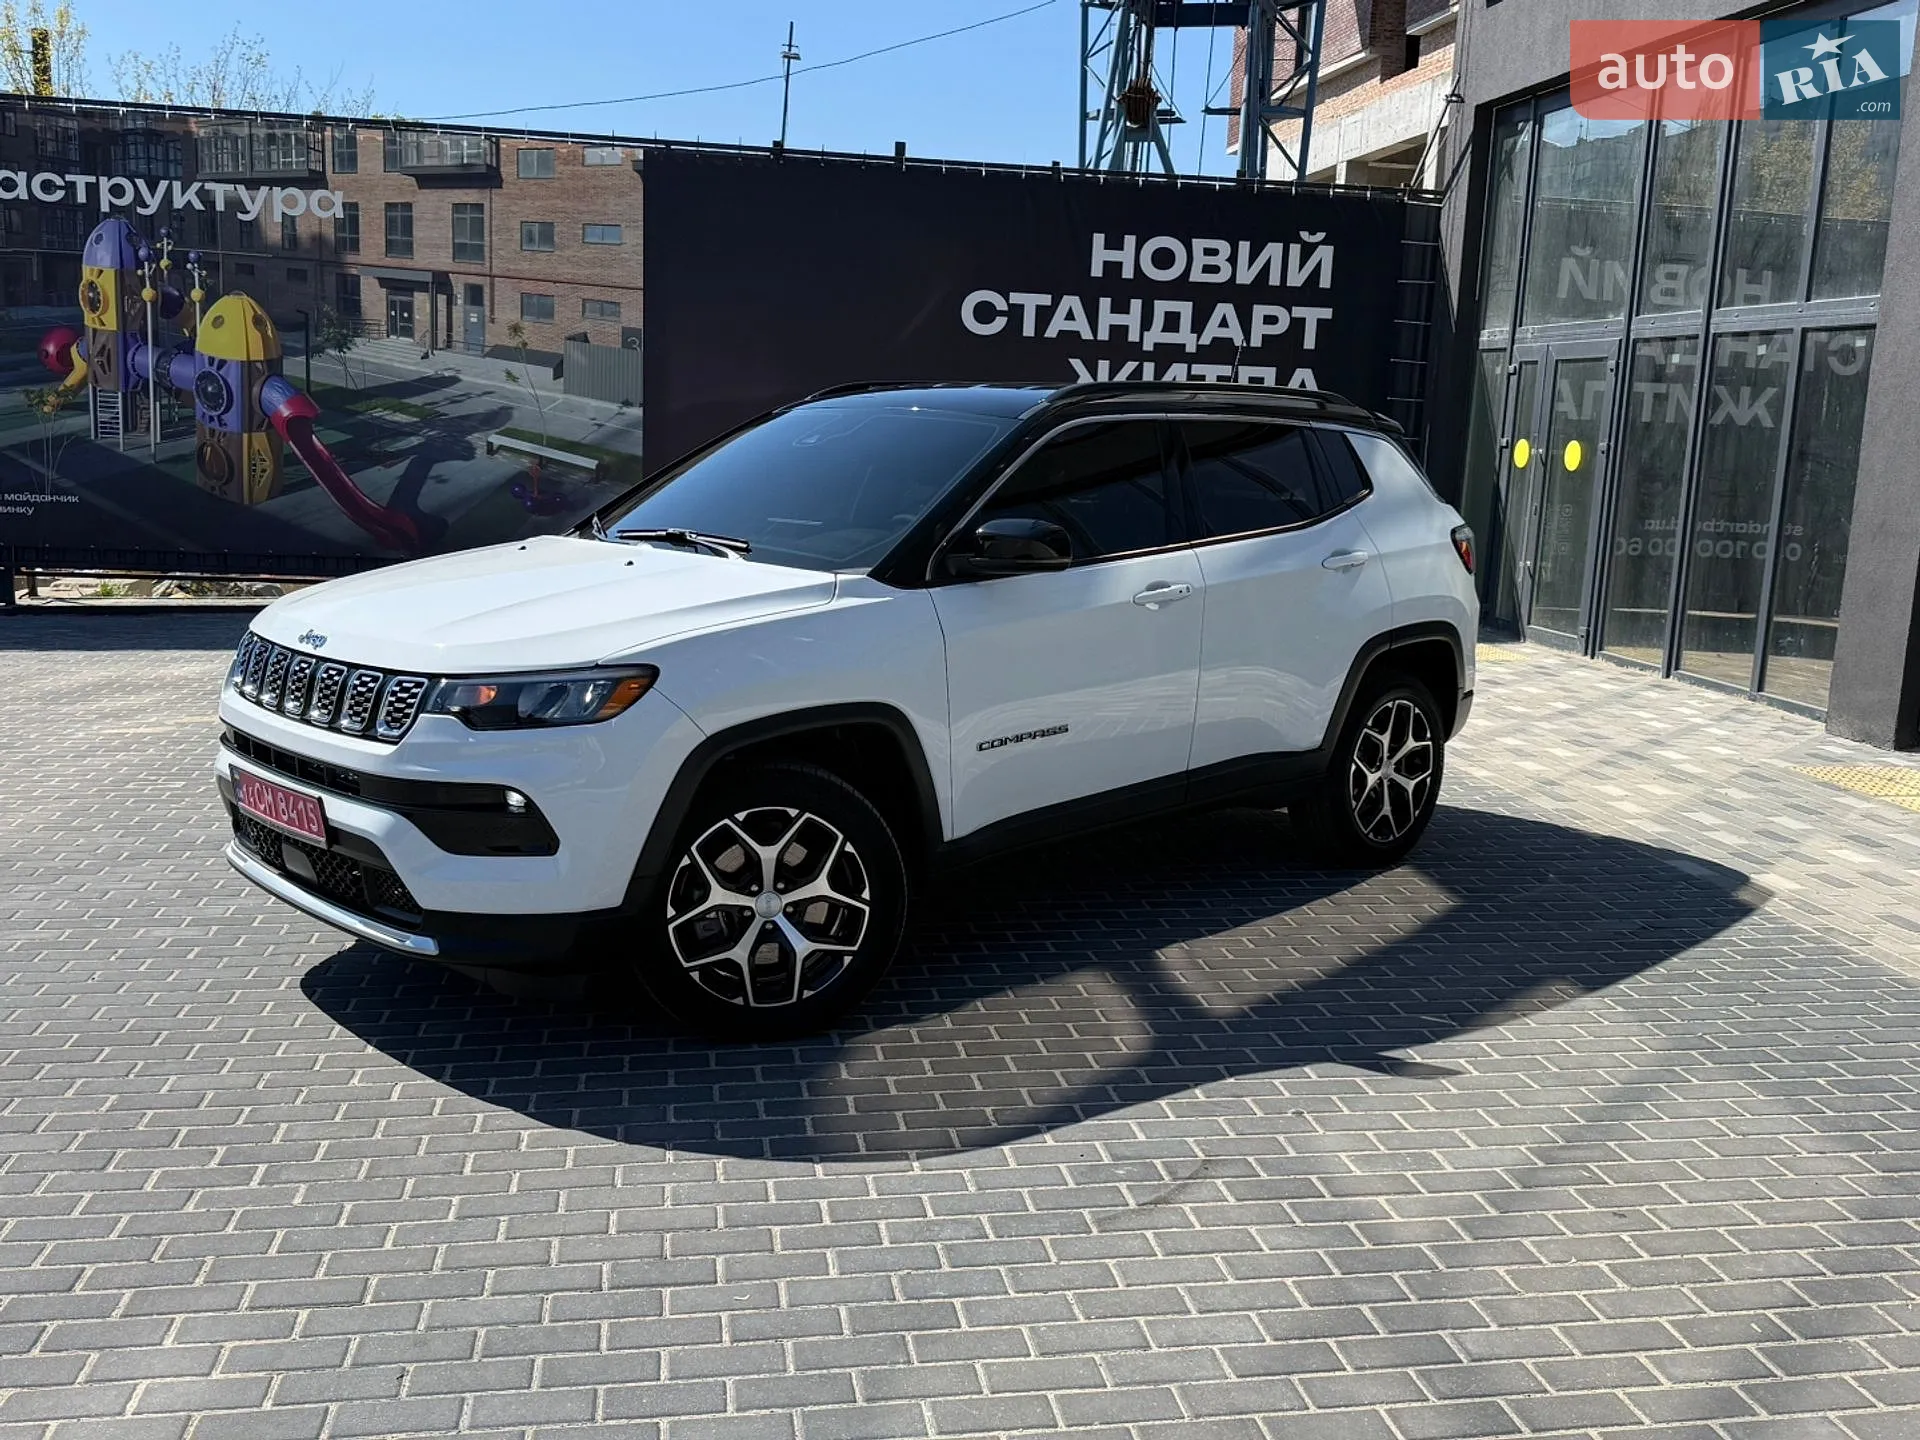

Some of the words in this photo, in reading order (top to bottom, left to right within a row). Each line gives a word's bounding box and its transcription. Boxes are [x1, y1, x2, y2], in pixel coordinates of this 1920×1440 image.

[0, 169, 344, 222] аструктура
[1090, 231, 1334, 289] НОВИЙ
[961, 289, 1333, 353] СТАНДАРТ
[4, 492, 79, 503] майданчик
[977, 724, 1069, 751] COMPASS
